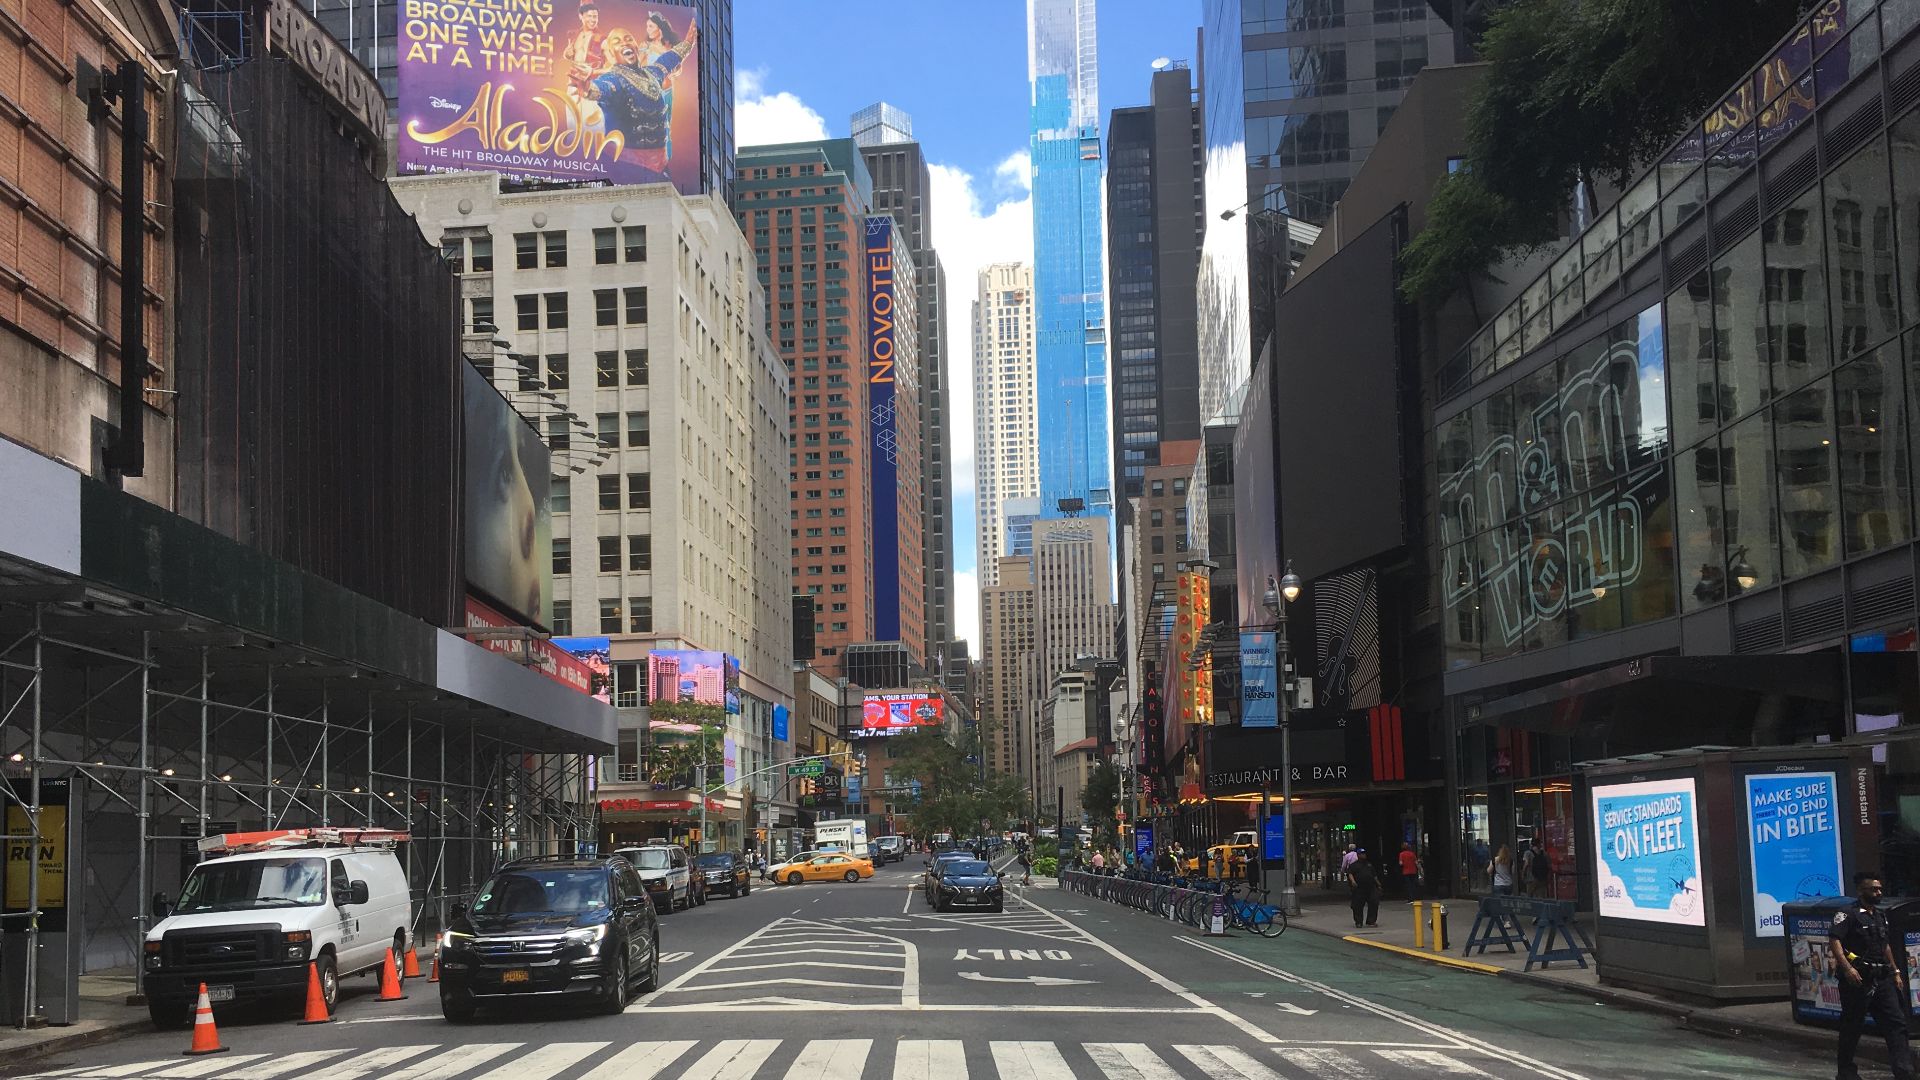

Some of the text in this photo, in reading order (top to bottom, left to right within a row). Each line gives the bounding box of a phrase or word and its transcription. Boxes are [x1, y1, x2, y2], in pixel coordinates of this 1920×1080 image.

[406, 0, 553, 33] BROADWAY
[405, 20, 553, 55] ONE WISH
[406, 41, 443, 64] AT
[451, 47, 472, 68] A
[407, 81, 624, 162] Aladdin
[422, 146, 607, 173] THE HIT BROADWAY MUSICAL
[868, 235, 894, 383] NOVOTEL
[1209, 766, 1347, 787] RESTAURANT & BAR
[1754, 782, 1826, 807] MAKE SURE
[1777, 803, 1799, 818] NO
[1802, 797, 1828, 813] END
[1858, 767, 1870, 825] Newsstand
[1604, 795, 1682, 829] SERVICE STANDARDS
[1756, 812, 1833, 844] IN BITE.
[1615, 827, 1640, 861] ON
[1642, 816, 1686, 856] FLEET.
[953, 949, 1073, 961] ONLY
